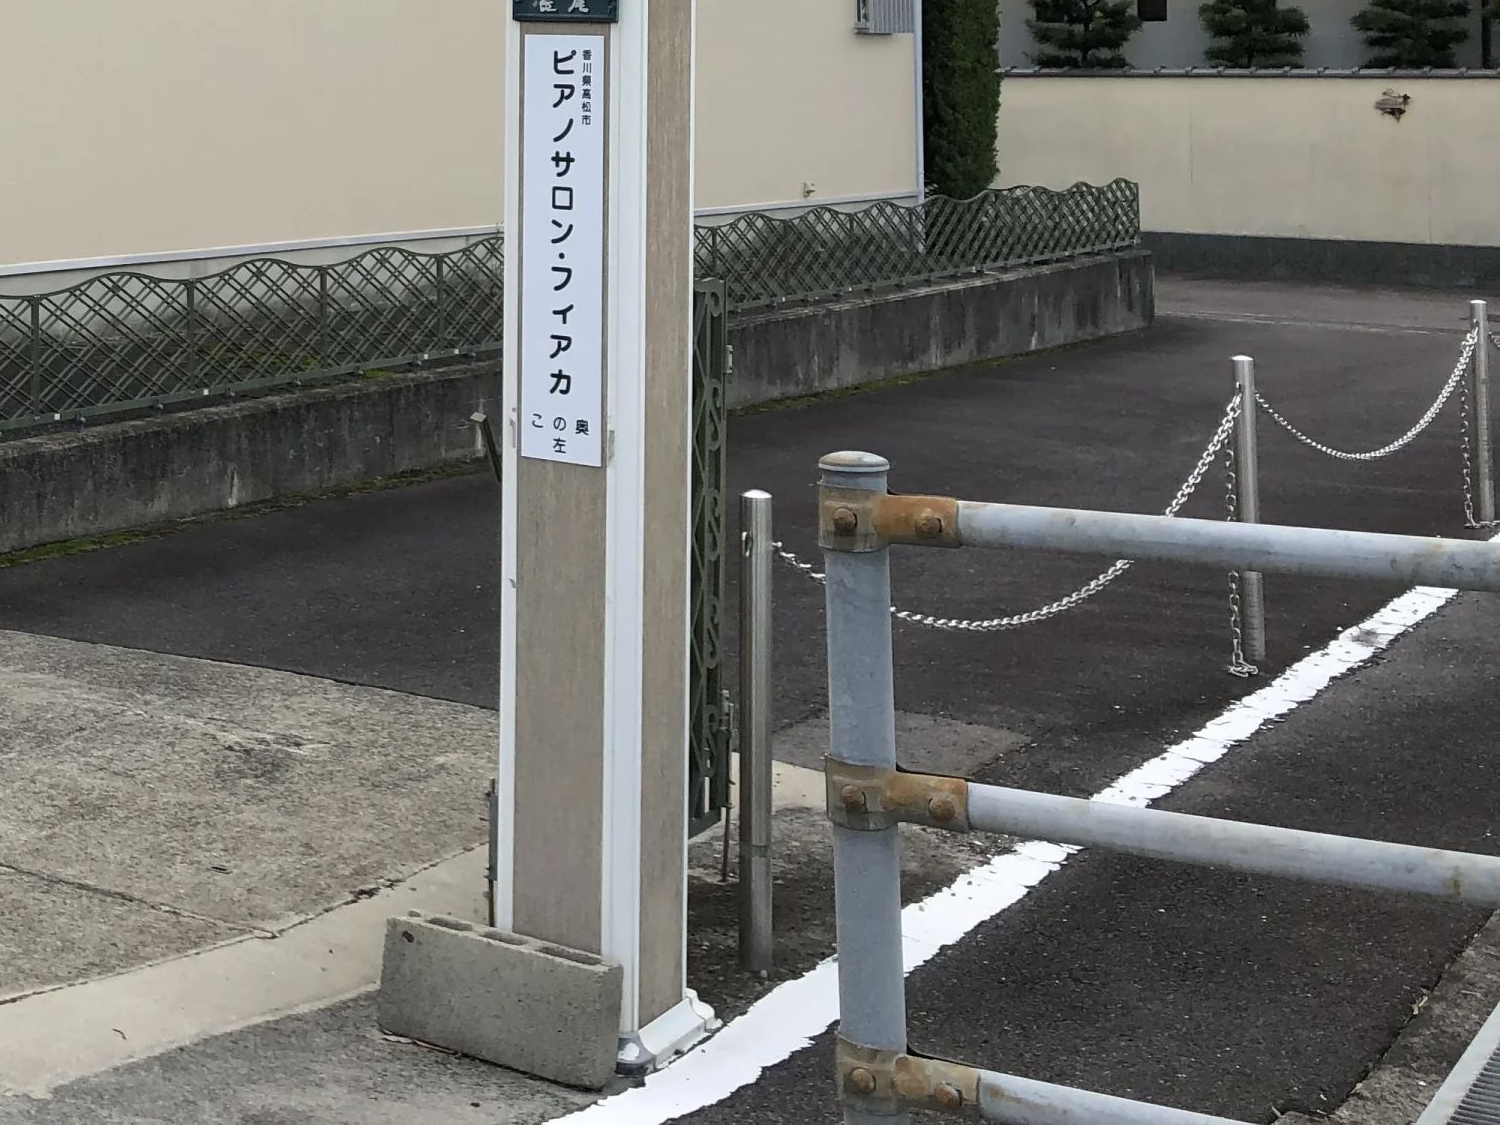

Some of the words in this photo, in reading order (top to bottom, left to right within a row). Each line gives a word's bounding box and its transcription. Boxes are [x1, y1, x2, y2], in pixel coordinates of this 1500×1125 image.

[581, 49, 592, 126] 香川県高松市
[549, 49, 577, 395] ピアノサロン・フィアカ
